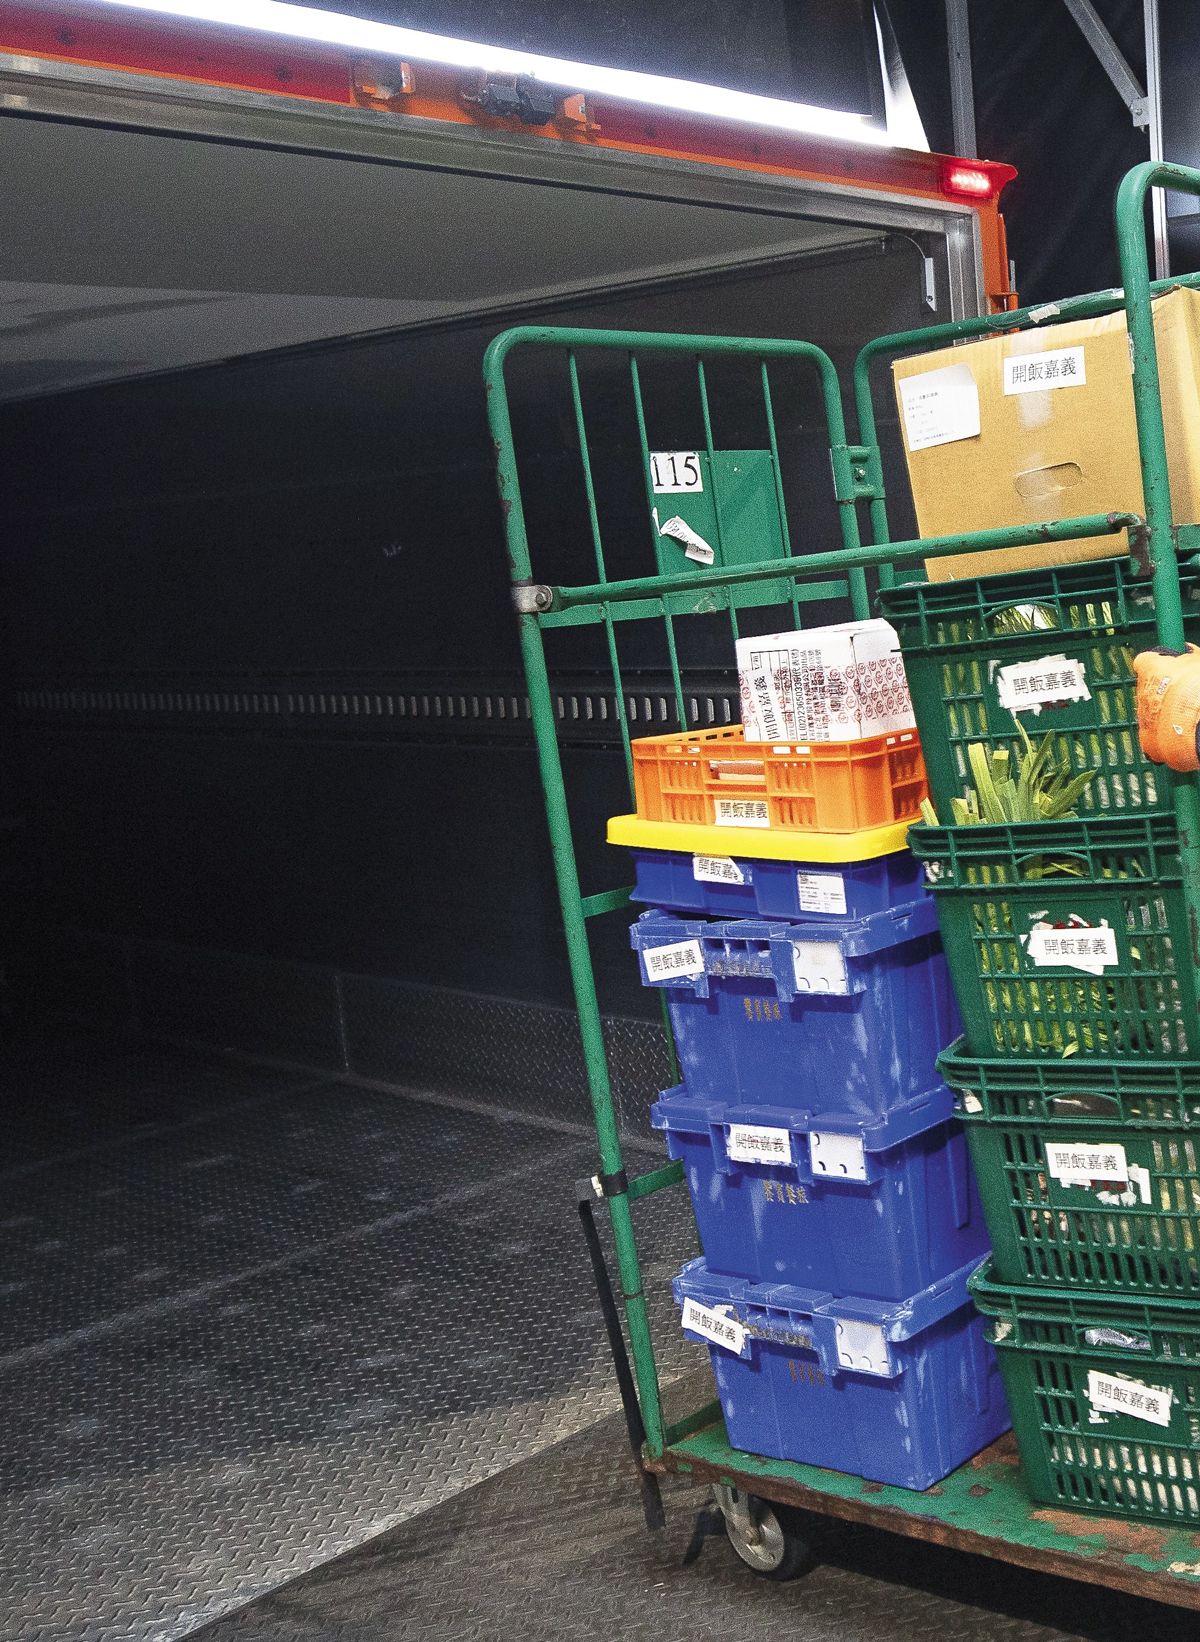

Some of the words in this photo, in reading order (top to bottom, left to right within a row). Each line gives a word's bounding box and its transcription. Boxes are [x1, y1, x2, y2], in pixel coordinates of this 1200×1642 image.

[1012, 356, 1077, 385] 開飯嘉義
[652, 456, 699, 487] 115
[1013, 670, 1077, 695] 開飯嘉義
[720, 802, 768, 819] 開飯嘉義
[1044, 938, 1108, 955] 開飯嘉義
[649, 949, 697, 973] 開飯嘉義
[1054, 1152, 1118, 1171] 開飯嘉義
[689, 1307, 737, 1343] 開飯嘉義
[1097, 1380, 1160, 1415] 開飯嘉義
